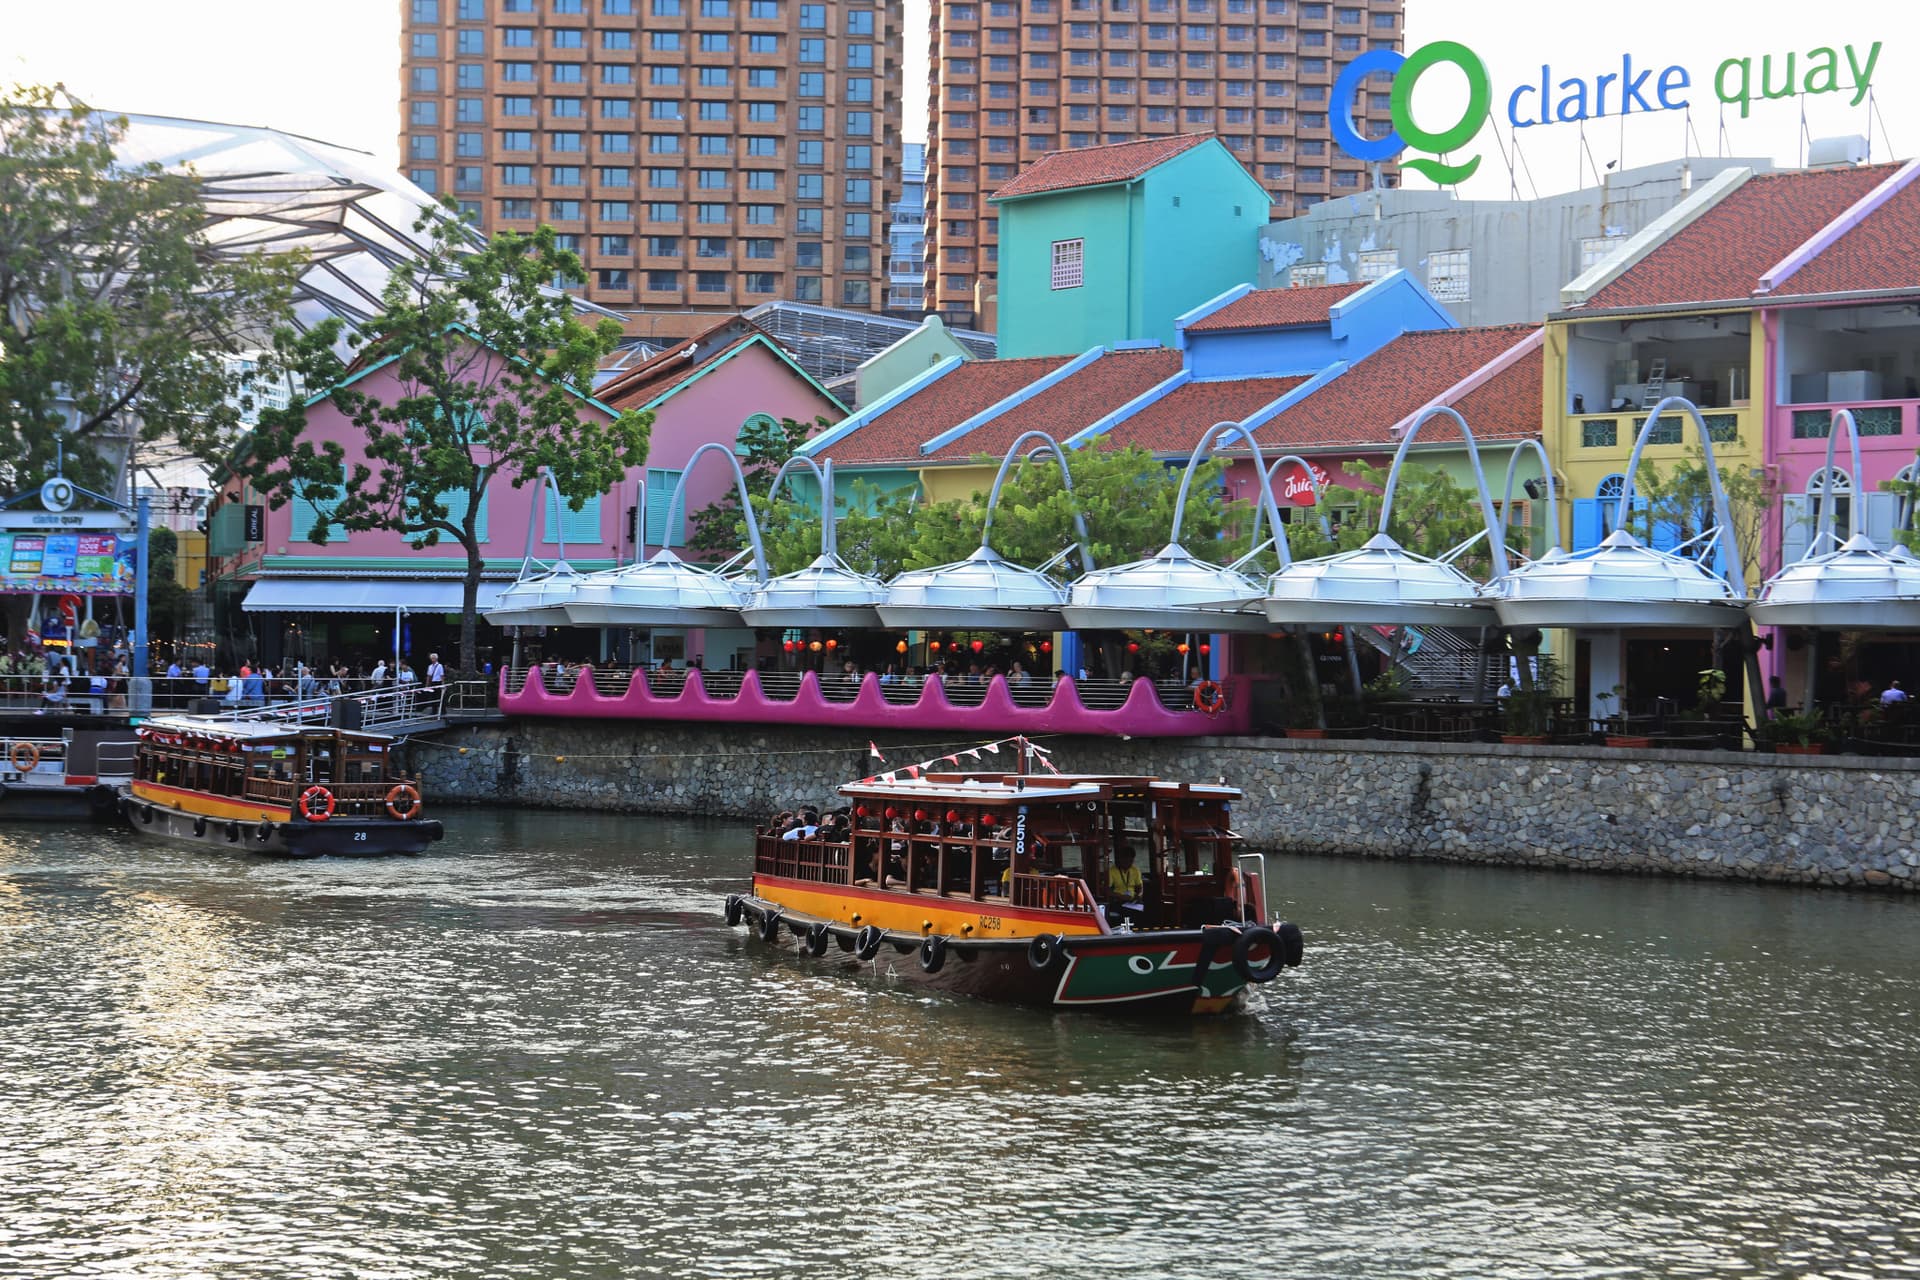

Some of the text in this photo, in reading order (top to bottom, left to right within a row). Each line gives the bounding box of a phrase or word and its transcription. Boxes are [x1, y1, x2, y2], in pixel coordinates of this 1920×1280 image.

[1508, 41, 1882, 127] clarke quay
[61, 516, 83, 526] quay
[354, 832, 367, 841] 28
[1016, 814, 1026, 854] 258
[980, 915, 1000, 930] RC258
